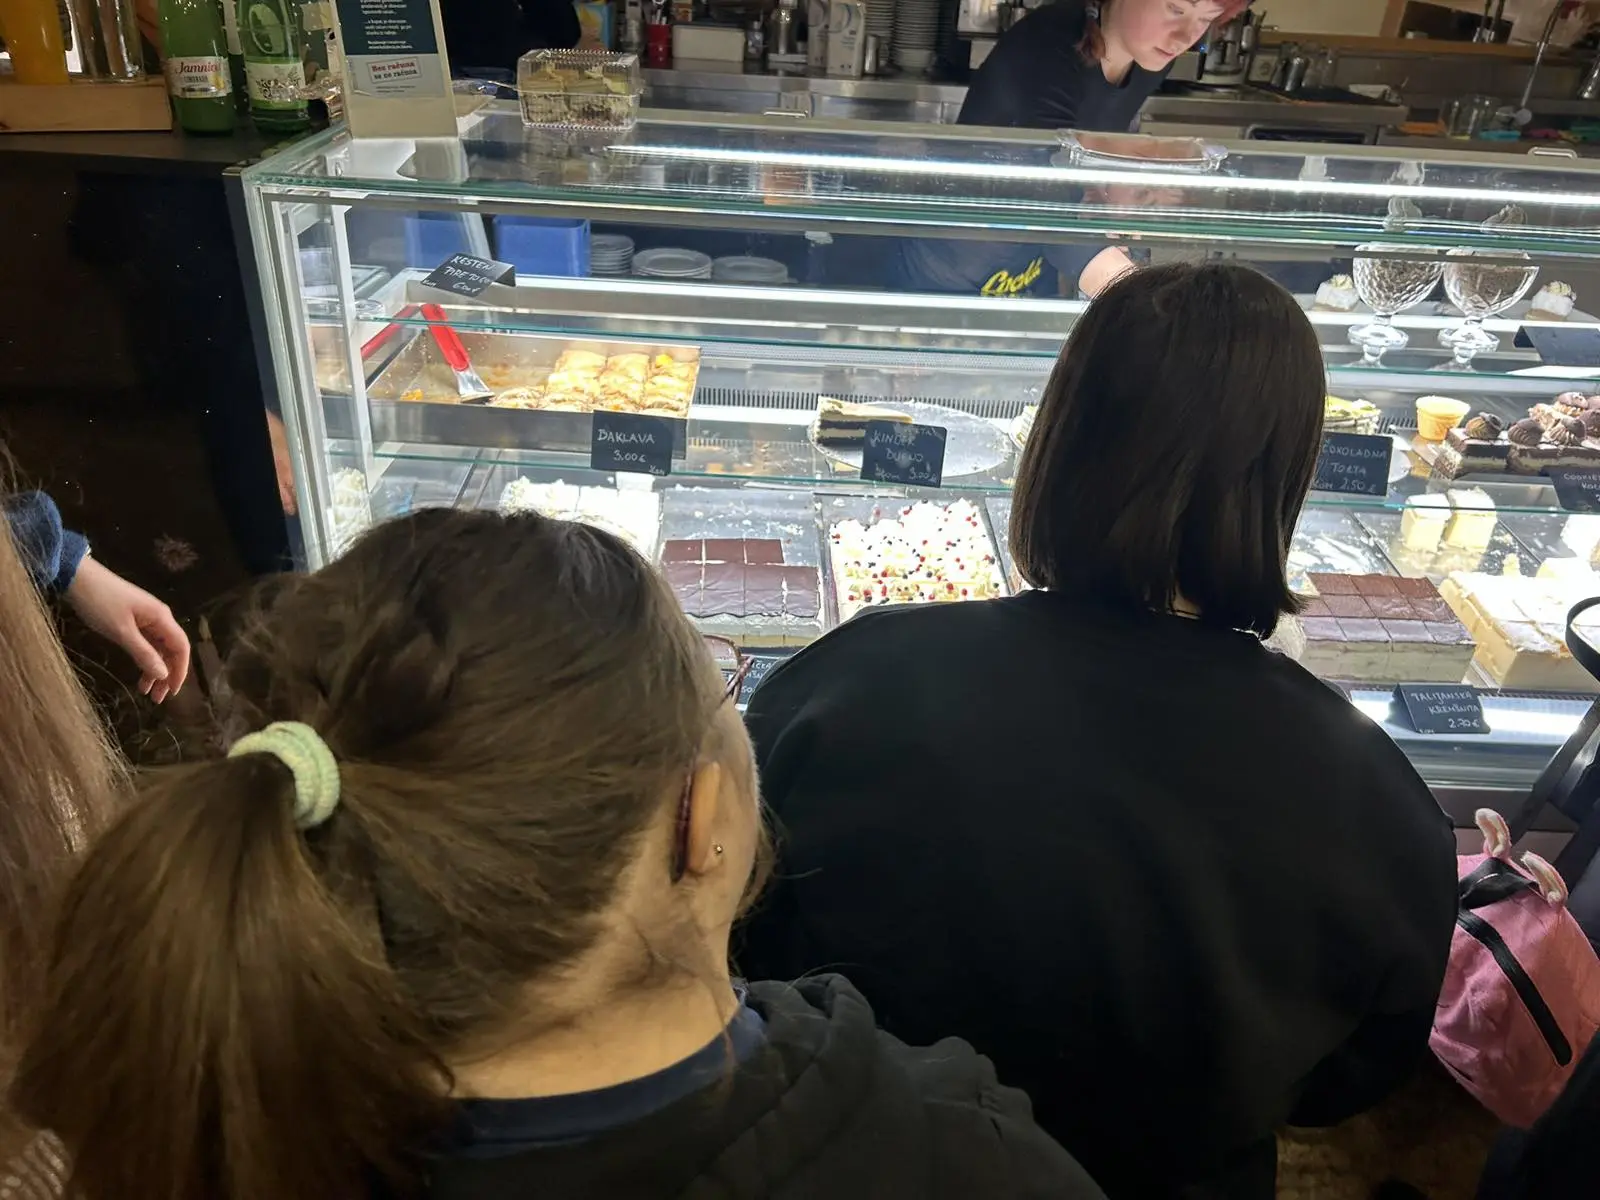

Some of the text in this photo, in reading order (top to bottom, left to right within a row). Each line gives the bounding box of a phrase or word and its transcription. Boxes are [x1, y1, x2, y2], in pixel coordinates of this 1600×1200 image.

[371, 61, 415, 72] Bez računa
[394, 69, 418, 77] računa
[450, 255, 495, 270] KESTEN
[597, 428, 656, 444] BAKLAVA
[1321, 439, 1388, 459] ČOKOLADNA
[1330, 462, 1367, 477] TORTA
[1563, 473, 1600, 481] COOKIE
[1411, 691, 1473, 705] TALIJANSKA
